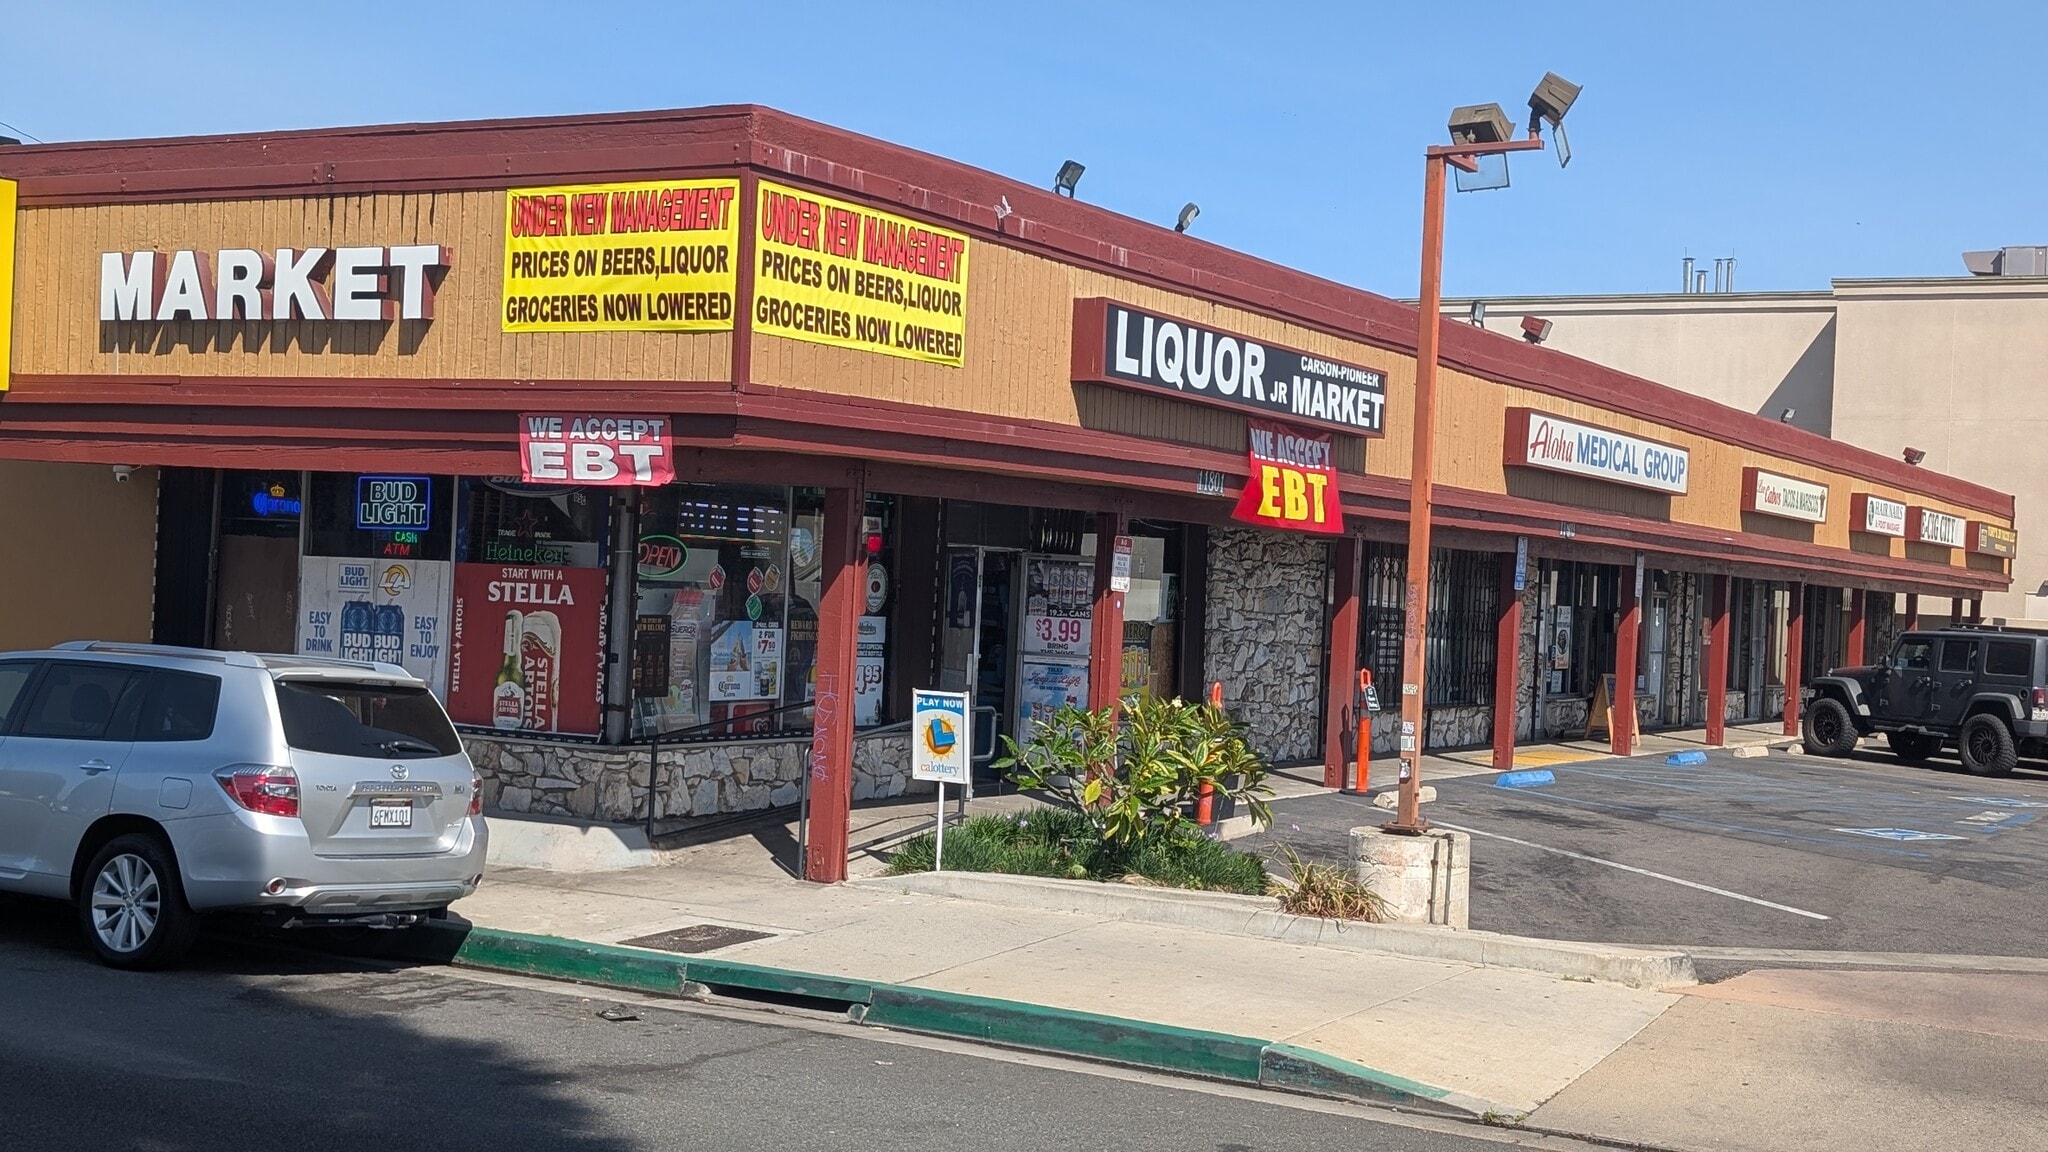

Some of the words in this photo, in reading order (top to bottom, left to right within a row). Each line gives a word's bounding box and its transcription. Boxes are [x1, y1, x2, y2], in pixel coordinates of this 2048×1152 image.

[511, 195, 567, 238] UNDER
[571, 192, 609, 235] NEW
[611, 187, 735, 233] MANAGEMENT
[762, 189, 820, 252] UNDER
[823, 205, 861, 260] NEW
[863, 215, 964, 284] MANAGEMENT
[511, 250, 569, 278] PRICES
[574, 249, 597, 277] ON
[601, 245, 728, 281] BEERS,LIQUOR
[101, 244, 441, 321] MARKET
[761, 249, 822, 288] PRICES
[827, 264, 850, 294] ON
[855, 270, 962, 316] BEERS,LIQUOR
[506, 294, 598, 323] GROCERIES
[603, 293, 642, 322] NOW
[647, 292, 732, 321] LOWERED
[756, 295, 851, 338] GROCERIES
[855, 314, 891, 345] NOW
[895, 322, 962, 358] LOWERED
[1115, 310, 1265, 402] LIQUOR
[1270, 380, 1288, 404] JR
[1291, 375, 1385, 429] MARKET
[1301, 356, 1379, 388] CARSON-PIONEER
[528, 416, 563, 439] WE
[568, 416, 664, 441] ACCEPT
[1250, 427, 1275, 461] WE
[1277, 433, 1330, 470] ACCEPT
[1529, 420, 1574, 464] Aloha
[1576, 432, 1639, 475] MEDICAL
[1643, 448, 1686, 484] GROUP
[528, 441, 664, 482] EBT
[370, 481, 417, 503] BUD
[1257, 465, 1328, 523] EBT
[360, 503, 426, 525] LIGHT
[1940, 515, 1956, 543] CITY
[384, 543, 411, 556] ATM
[486, 541, 565, 564] Heineken
[639, 543, 682, 569] OPEN
[340, 575, 369, 587] LIGHT
[345, 566, 365, 577] BUD
[502, 568, 529, 580] START
[531, 569, 555, 580] WITH
[556, 570, 563, 581] A
[488, 581, 575, 605] STELLA
[309, 611, 332, 625] EASY
[414, 616, 438, 630] EASY
[455, 597, 464, 639] ARTOIS
[1069, 610, 1091, 618] CANS
[314, 625, 326, 638] TO
[344, 633, 371, 648] BUD
[374, 635, 401, 649] BUD
[420, 631, 432, 643] TO
[758, 631, 763, 639] 2
[764, 631, 775, 639] FOR
[1036, 618, 1082, 643] $3.99
[305, 638, 333, 653] DRINK
[410, 644, 440, 659] ENJOY
[452, 652, 461, 693] STELLA
[523, 656, 535, 729] ARTOIS
[534, 657, 548, 729] STELLA
[718, 681, 741, 693] Corona
[917, 697, 939, 706] PLAY
[943, 699, 963, 709] NOW
[920, 761, 959, 777] calottery
